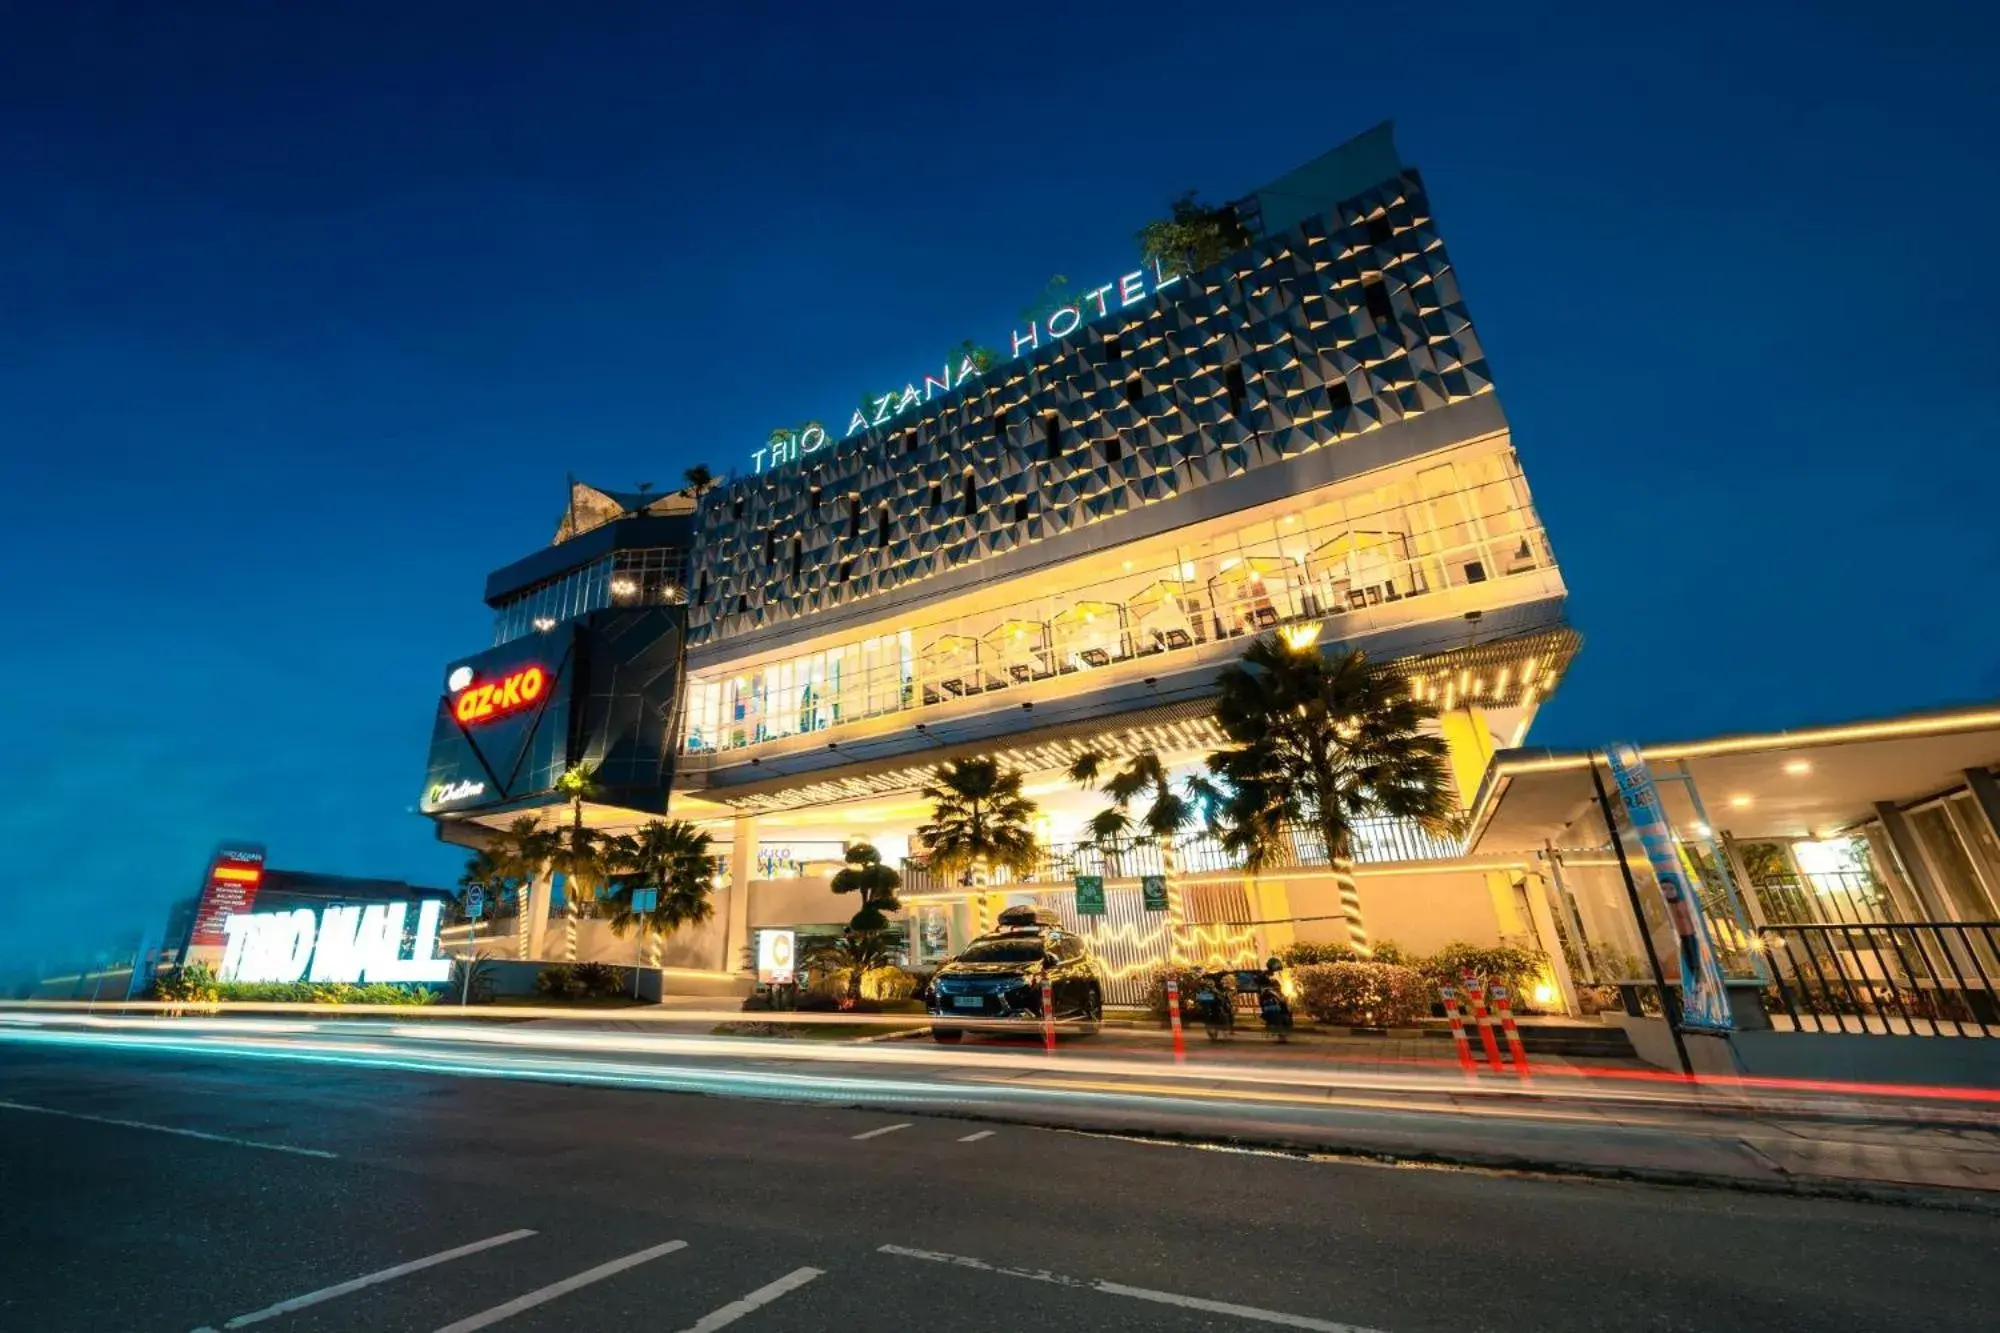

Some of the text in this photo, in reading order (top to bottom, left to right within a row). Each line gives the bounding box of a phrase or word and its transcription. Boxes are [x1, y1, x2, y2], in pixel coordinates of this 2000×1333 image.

[751, 258, 1181, 474] TRIO AZANA HOTEL
[312, 902, 450, 982] MALL
